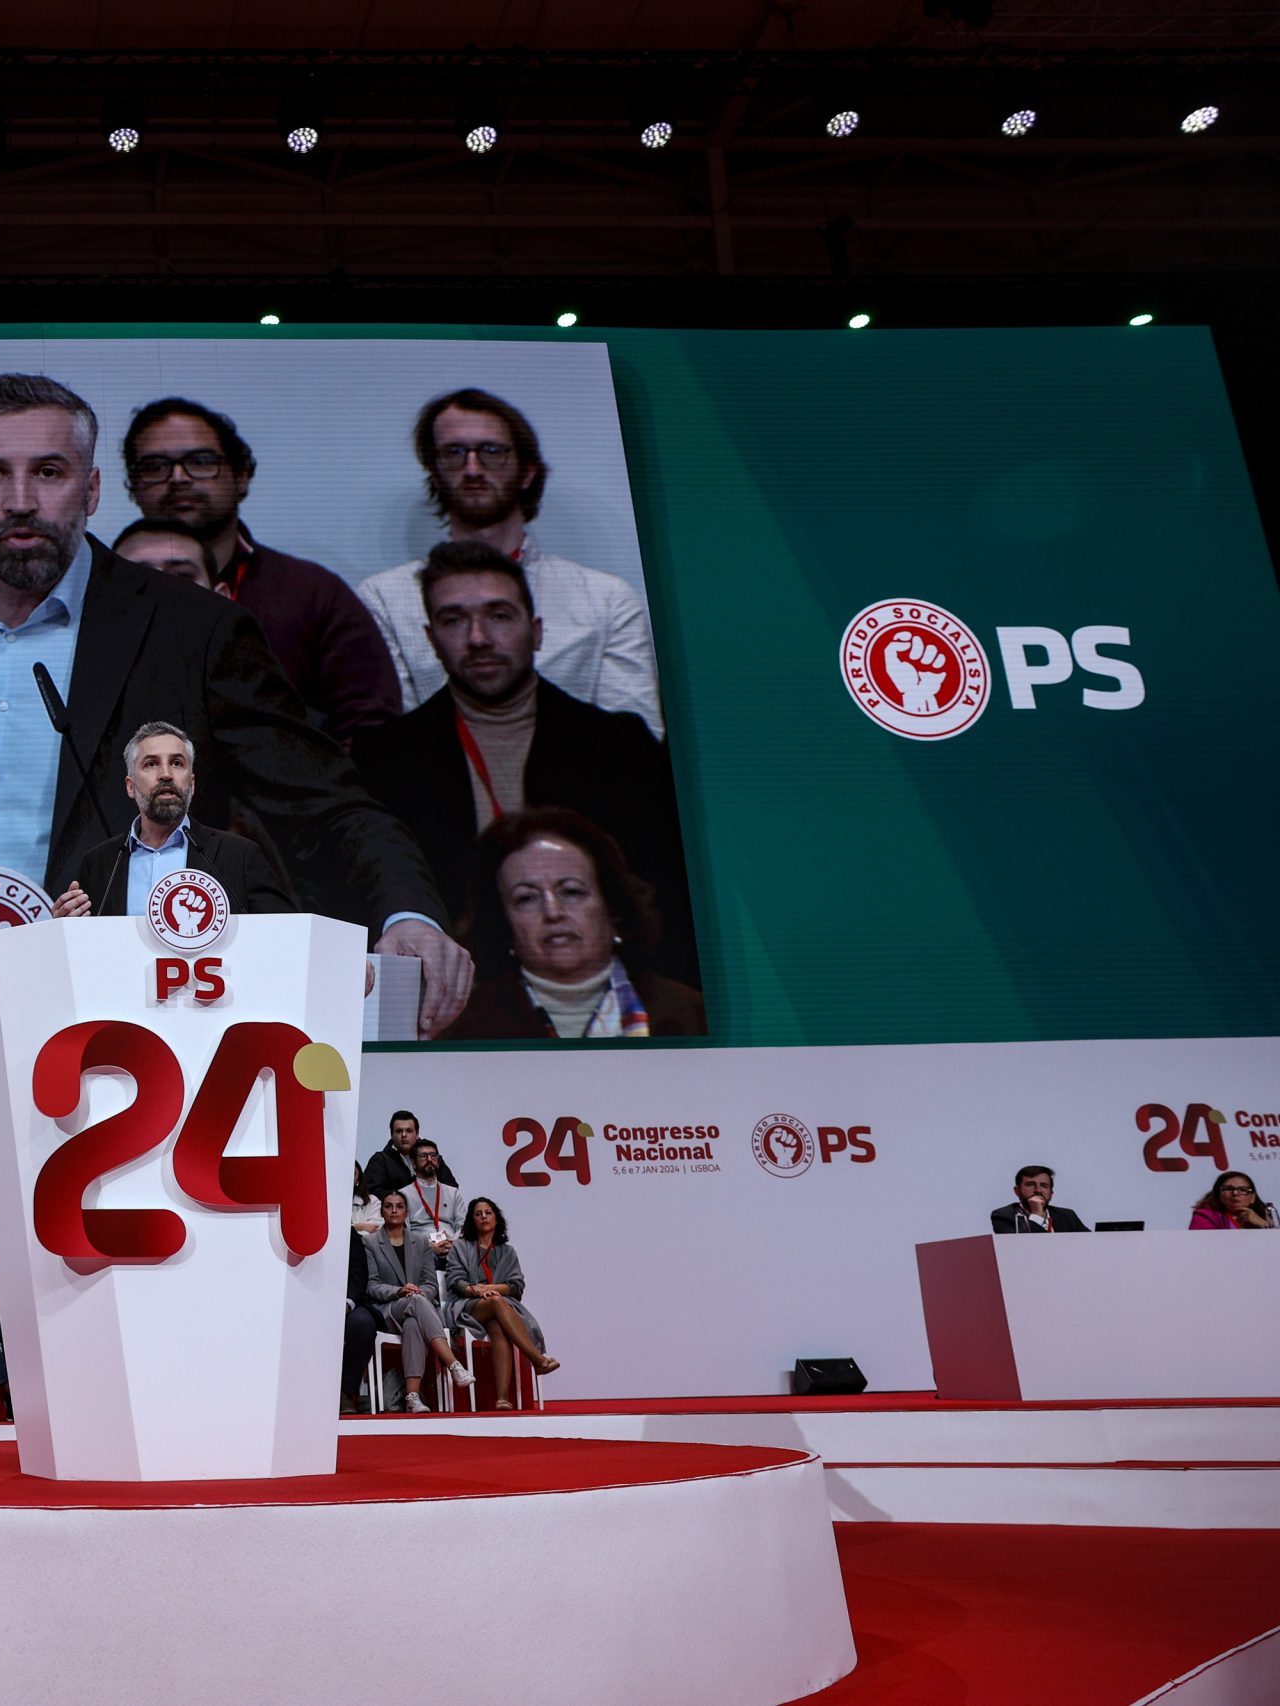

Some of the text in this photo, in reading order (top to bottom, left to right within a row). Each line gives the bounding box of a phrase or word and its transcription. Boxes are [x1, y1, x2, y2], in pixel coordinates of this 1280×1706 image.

[849, 606, 982, 709] PARTIDO SOCIALISTA
[995, 624, 1146, 711] PS
[152, 873, 225, 934] PARTIDO SOCIALISTA
[155, 957, 225, 1000] PS
[32, 1019, 329, 1258] 24
[603, 1123, 720, 1145] Congresso
[753, 1116, 812, 1166] PARTIDO SOCIALISTA
[1135, 1103, 1229, 1172] 24
[1235, 1110, 1280, 1128] Con
[1249, 1130, 1280, 1148] Na
[502, 1116, 592, 1188] 24
[615, 1142, 714, 1162] Nacional
[817, 1125, 876, 1163] PS
[612, 1166, 621, 1176] 5,
[621, 1166, 627, 1175] 6
[628, 1167, 634, 1175] e
[635, 1165, 640, 1174] 7
[641, 1165, 658, 1174] JAN
[660, 1165, 680, 1174] 2024
[690, 1163, 721, 1173] LISBOA
